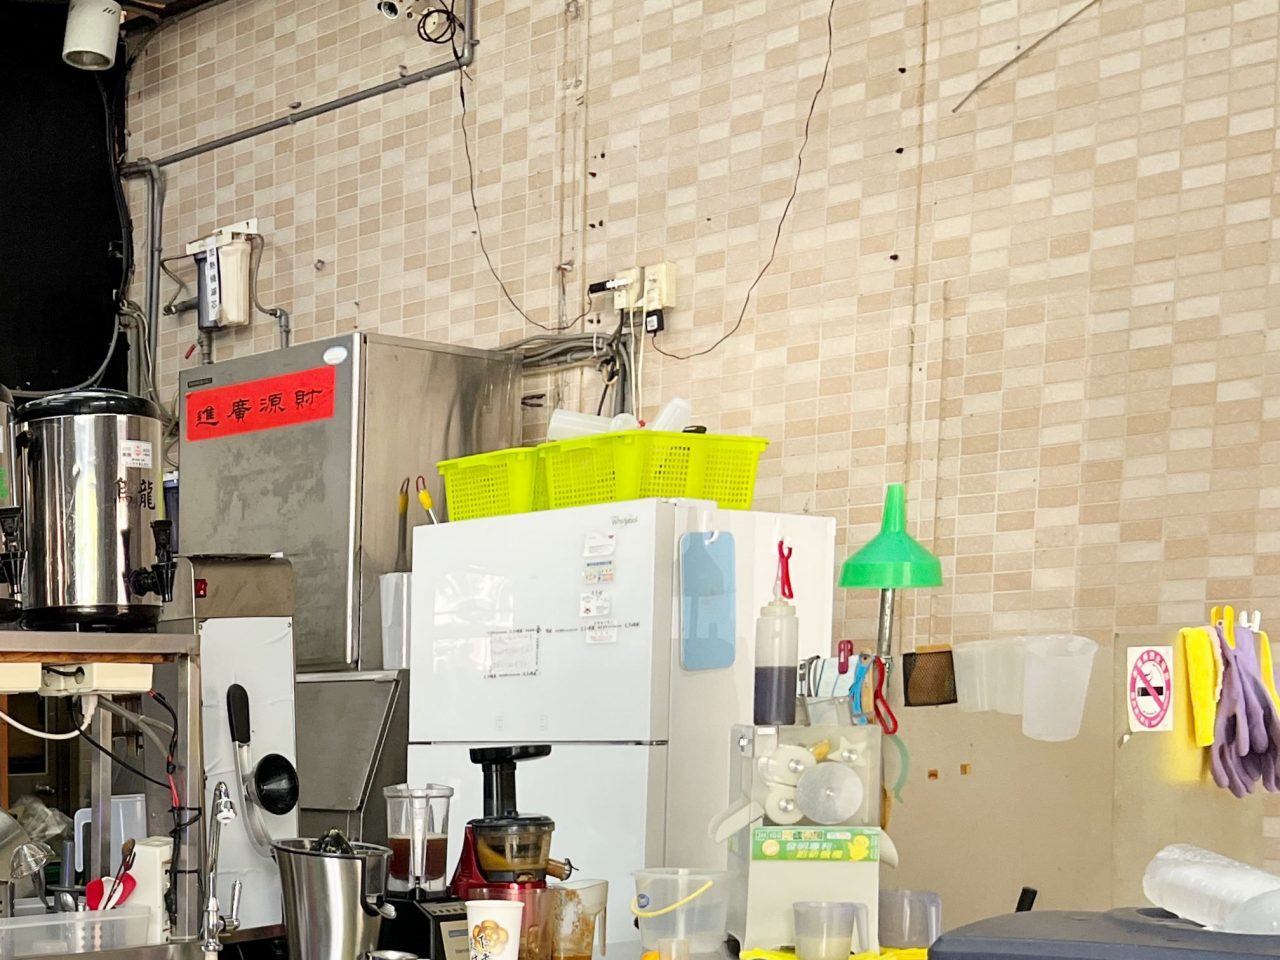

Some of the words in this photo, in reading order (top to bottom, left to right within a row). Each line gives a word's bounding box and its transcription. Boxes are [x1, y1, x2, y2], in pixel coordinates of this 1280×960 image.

[195, 388, 323, 427] 財源廣進
[114, 477, 155, 510] 烏龍
